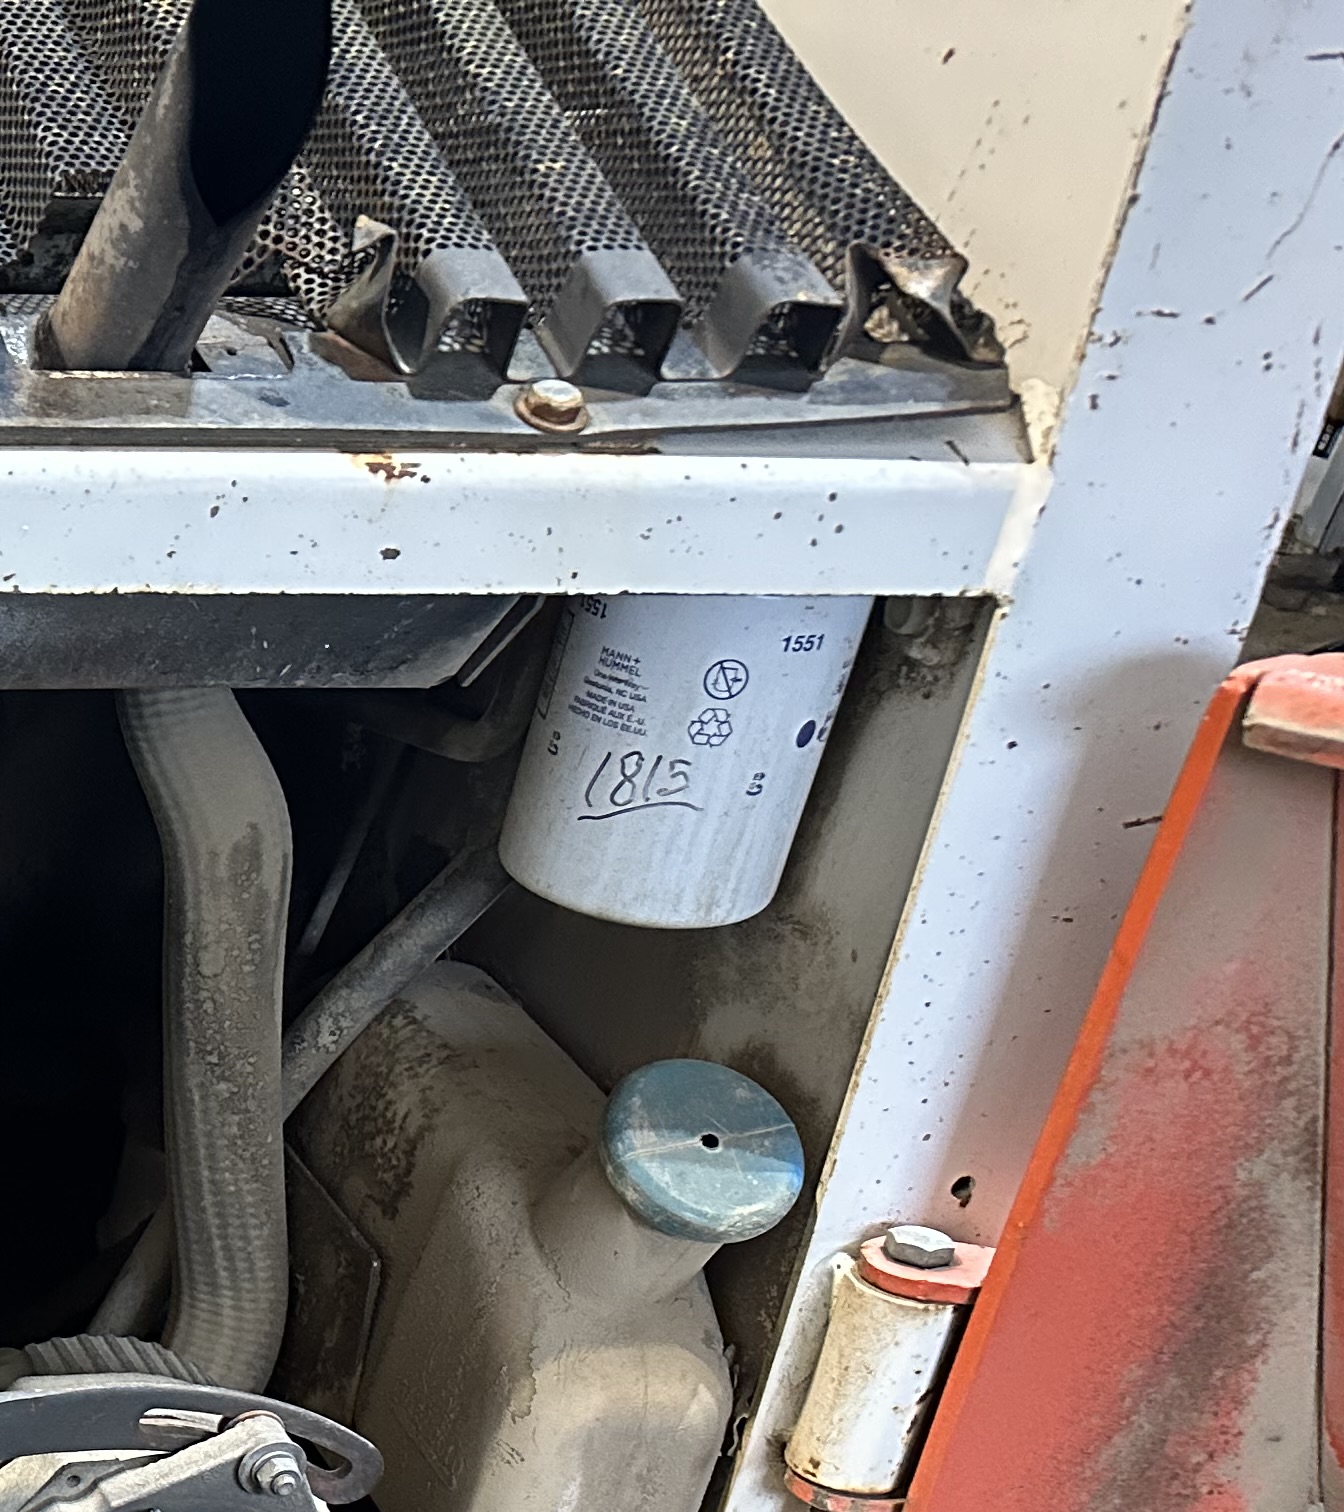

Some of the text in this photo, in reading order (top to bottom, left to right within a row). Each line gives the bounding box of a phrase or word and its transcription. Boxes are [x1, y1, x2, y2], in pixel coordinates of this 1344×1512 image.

[782, 634, 825, 652] 1551
[600, 646, 631, 663] MANN
[597, 656, 641, 677] HUMMEL
[585, 751, 691, 807] 1815
